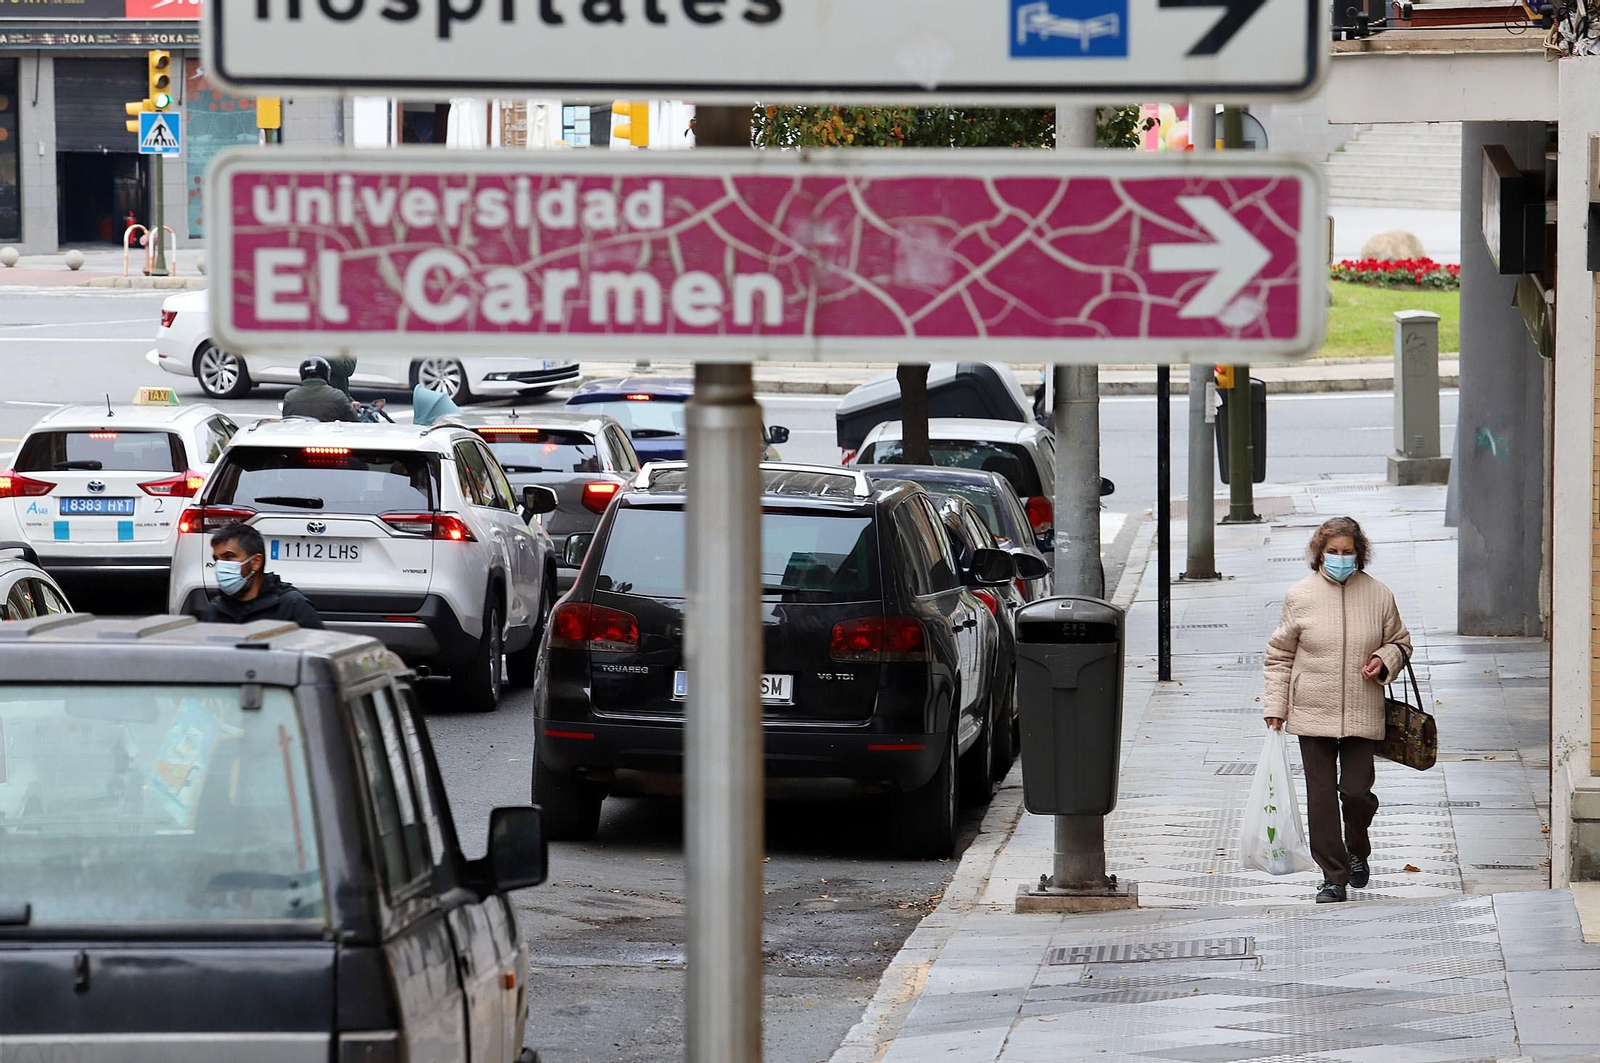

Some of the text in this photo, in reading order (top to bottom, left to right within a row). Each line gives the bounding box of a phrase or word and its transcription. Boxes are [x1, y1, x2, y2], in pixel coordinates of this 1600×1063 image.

[64, 34, 95, 43] TOKA
[154, 34, 184, 43] TOKA
[252, 174, 664, 229] universidad
[254, 248, 783, 326] El Carmen
[149, 390, 168, 401] TAXI
[70, 499, 131, 512] 8383 HYT
[153, 498, 164, 513] 2
[285, 542, 323, 559] 1112
[329, 544, 358, 560] LHS
[602, 664, 649, 674] TOUAREG
